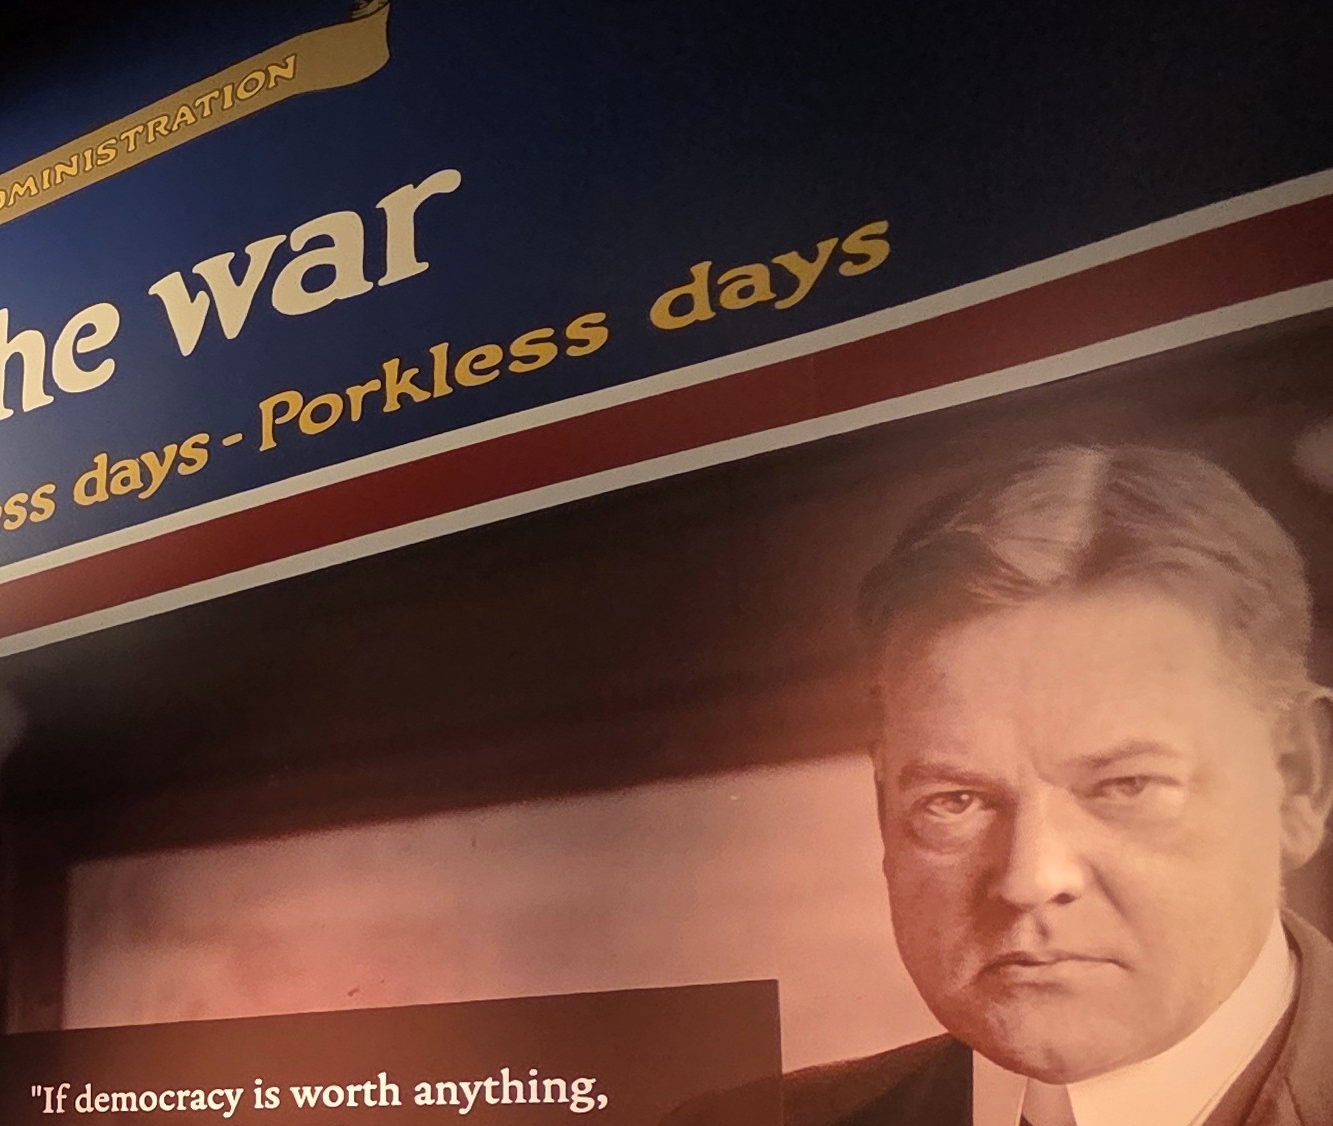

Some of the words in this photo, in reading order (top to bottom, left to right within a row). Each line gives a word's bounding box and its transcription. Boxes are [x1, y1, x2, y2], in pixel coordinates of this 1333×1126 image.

[148, 169, 462, 357] war
[72, 432, 210, 506] days
[259, 311, 610, 452] Porkless
[649, 220, 890, 331] days
[74, 1083, 244, 1119] democracy
[253, 1078, 281, 1110] is
[290, 1071, 402, 1109] worth
[414, 1067, 609, 1115] anything,
